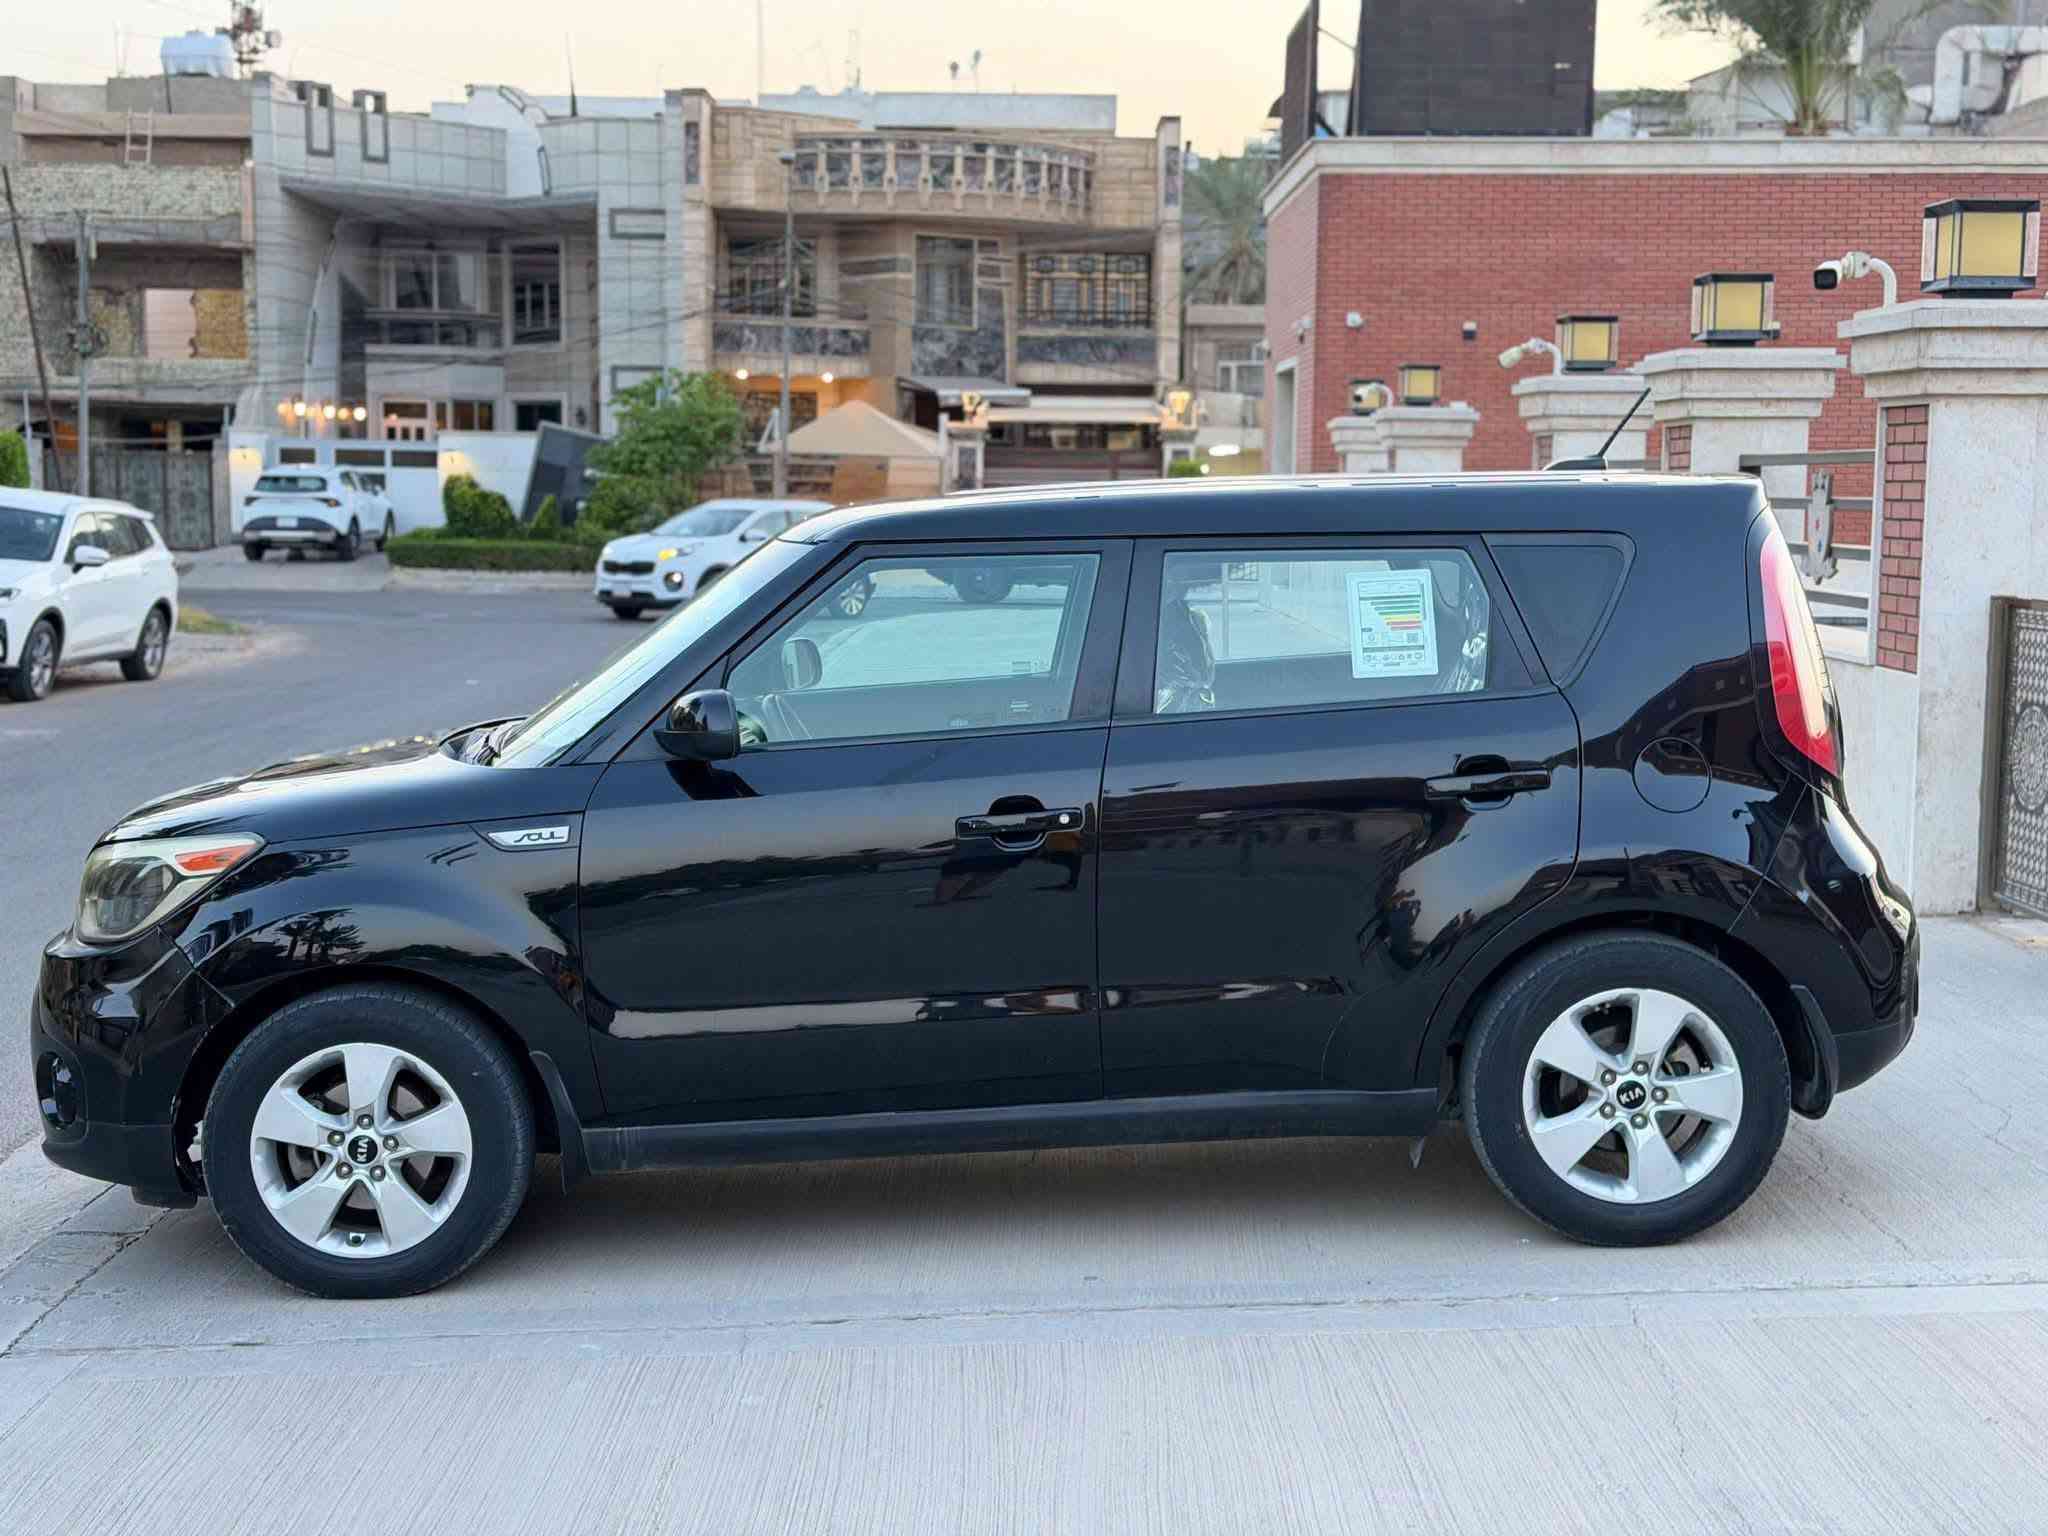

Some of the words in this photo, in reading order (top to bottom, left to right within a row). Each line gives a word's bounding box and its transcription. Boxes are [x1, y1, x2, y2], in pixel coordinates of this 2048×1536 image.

[514, 832, 564, 843] SOUL
[1619, 1087, 1645, 1105] KIA
[356, 1138, 369, 1162] KIA
